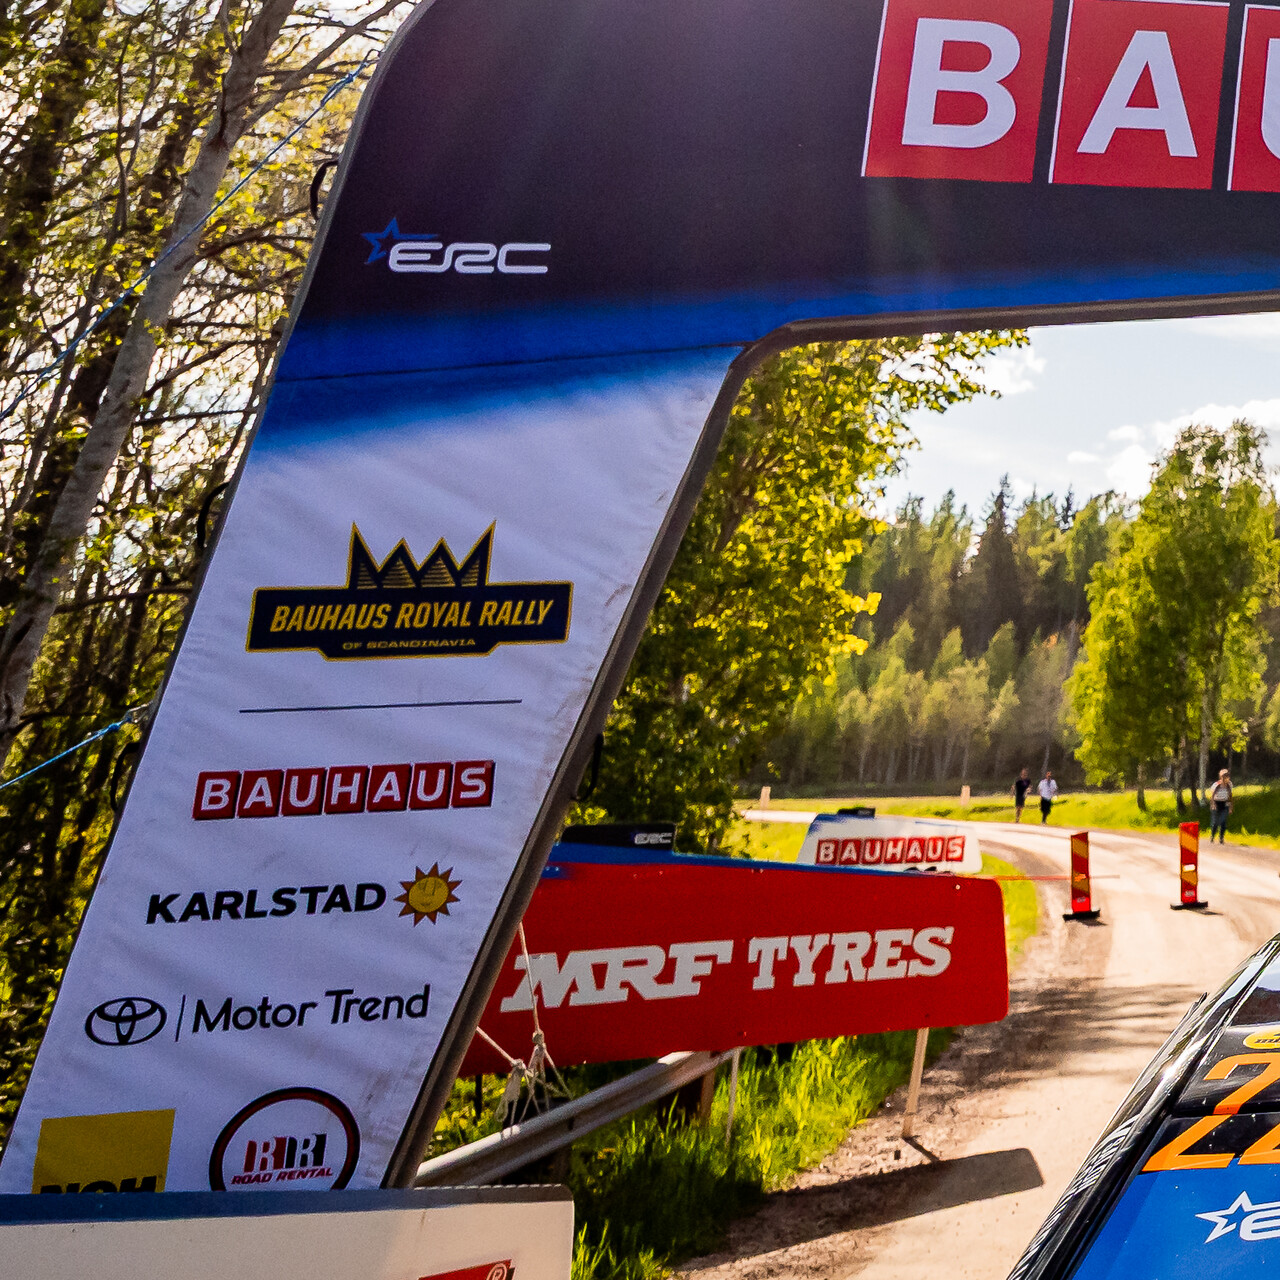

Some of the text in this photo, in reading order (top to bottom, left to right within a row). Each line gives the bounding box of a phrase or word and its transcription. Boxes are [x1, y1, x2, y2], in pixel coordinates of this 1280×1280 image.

[388, 242, 552, 275] ERC
[270, 600, 554, 633] BAUHAUS ROYAL RALLY
[342, 638, 476, 651] OF SCANDINAVIA
[201, 766, 486, 811] BAUHAUS
[819, 838, 963, 862] BAUHAUS
[146, 882, 387, 925] KARLSTAD
[501, 926, 954, 1012] MRF TYRES
[192, 983, 431, 1034] Motor Trend
[231, 1167, 333, 1185] ROAD RENTAL
